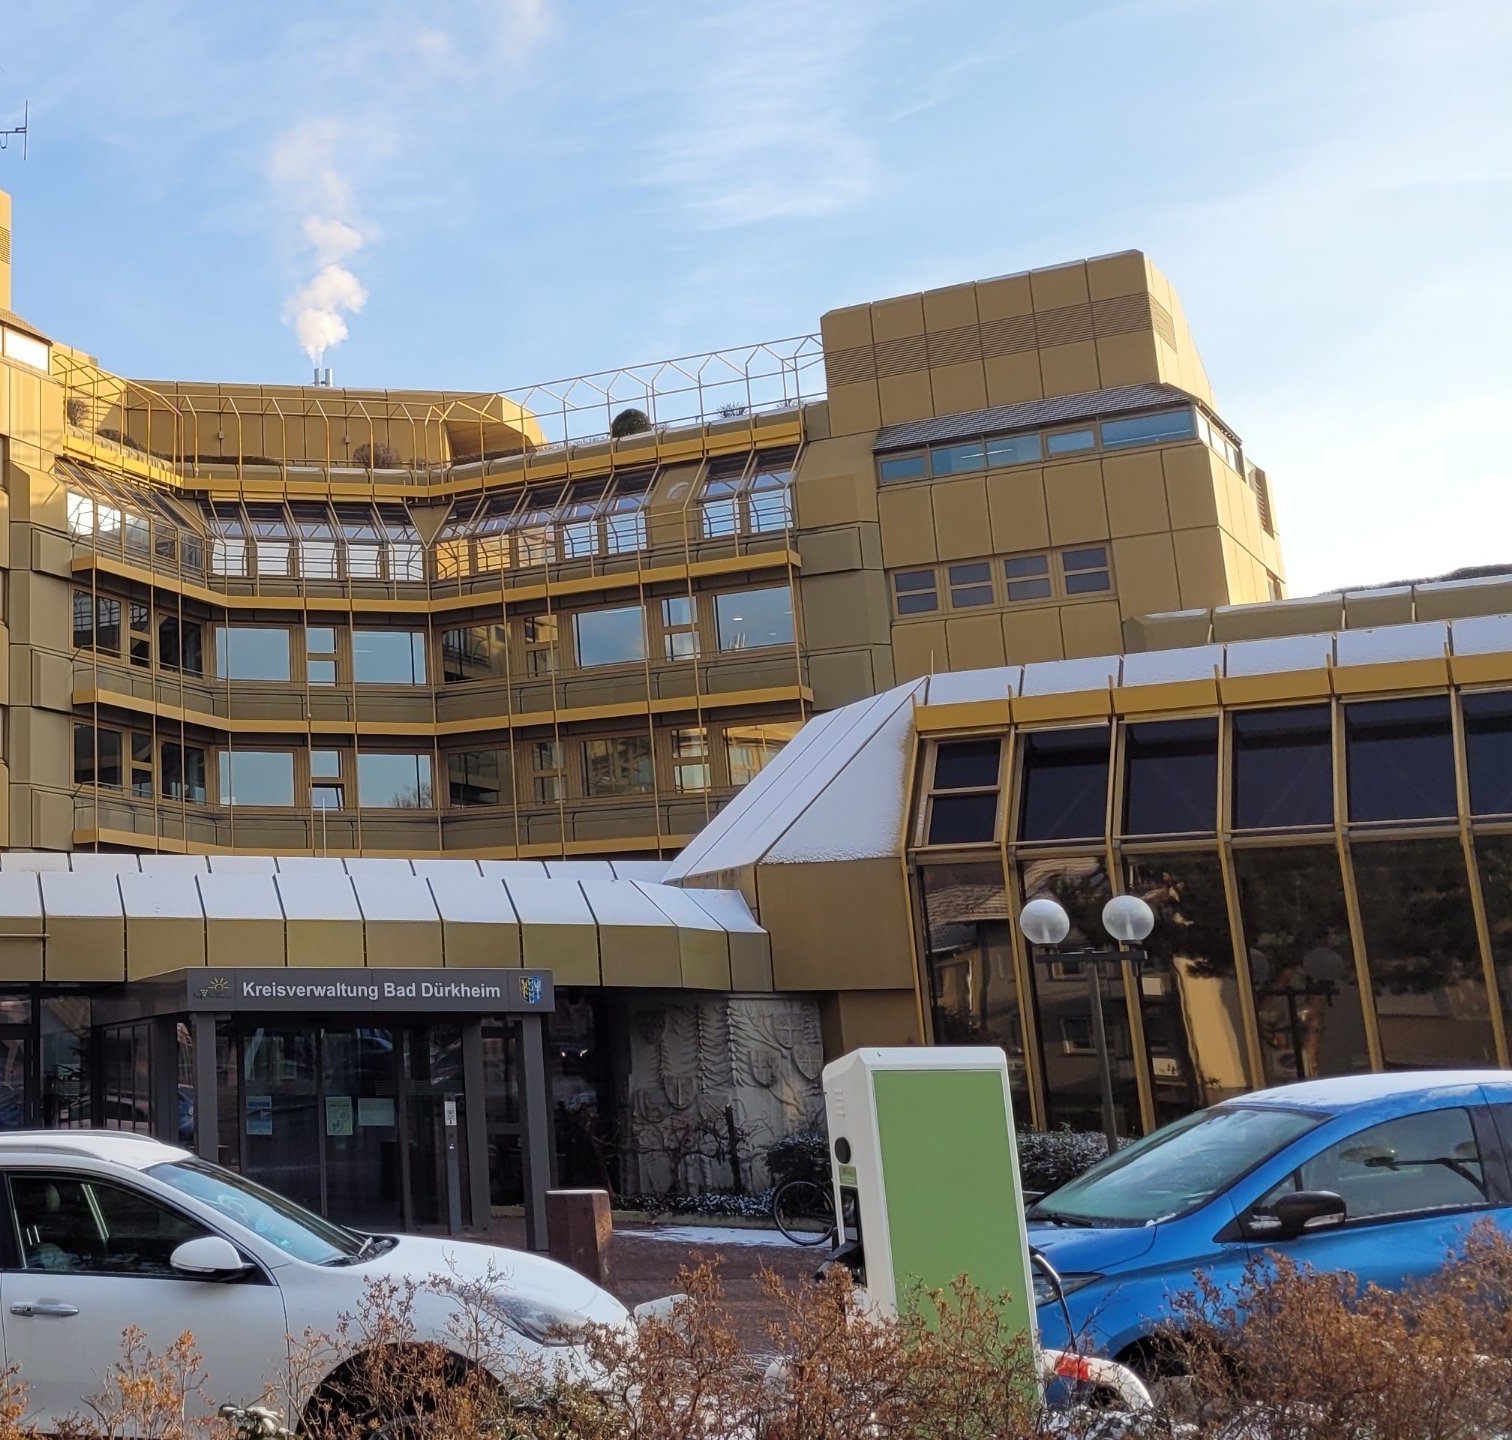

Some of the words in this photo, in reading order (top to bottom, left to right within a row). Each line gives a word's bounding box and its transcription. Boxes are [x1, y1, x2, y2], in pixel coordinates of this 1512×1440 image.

[242, 981, 379, 1001] Kreisverwaltung
[383, 983, 416, 998] Bad
[421, 982, 501, 998] Dürkheim
